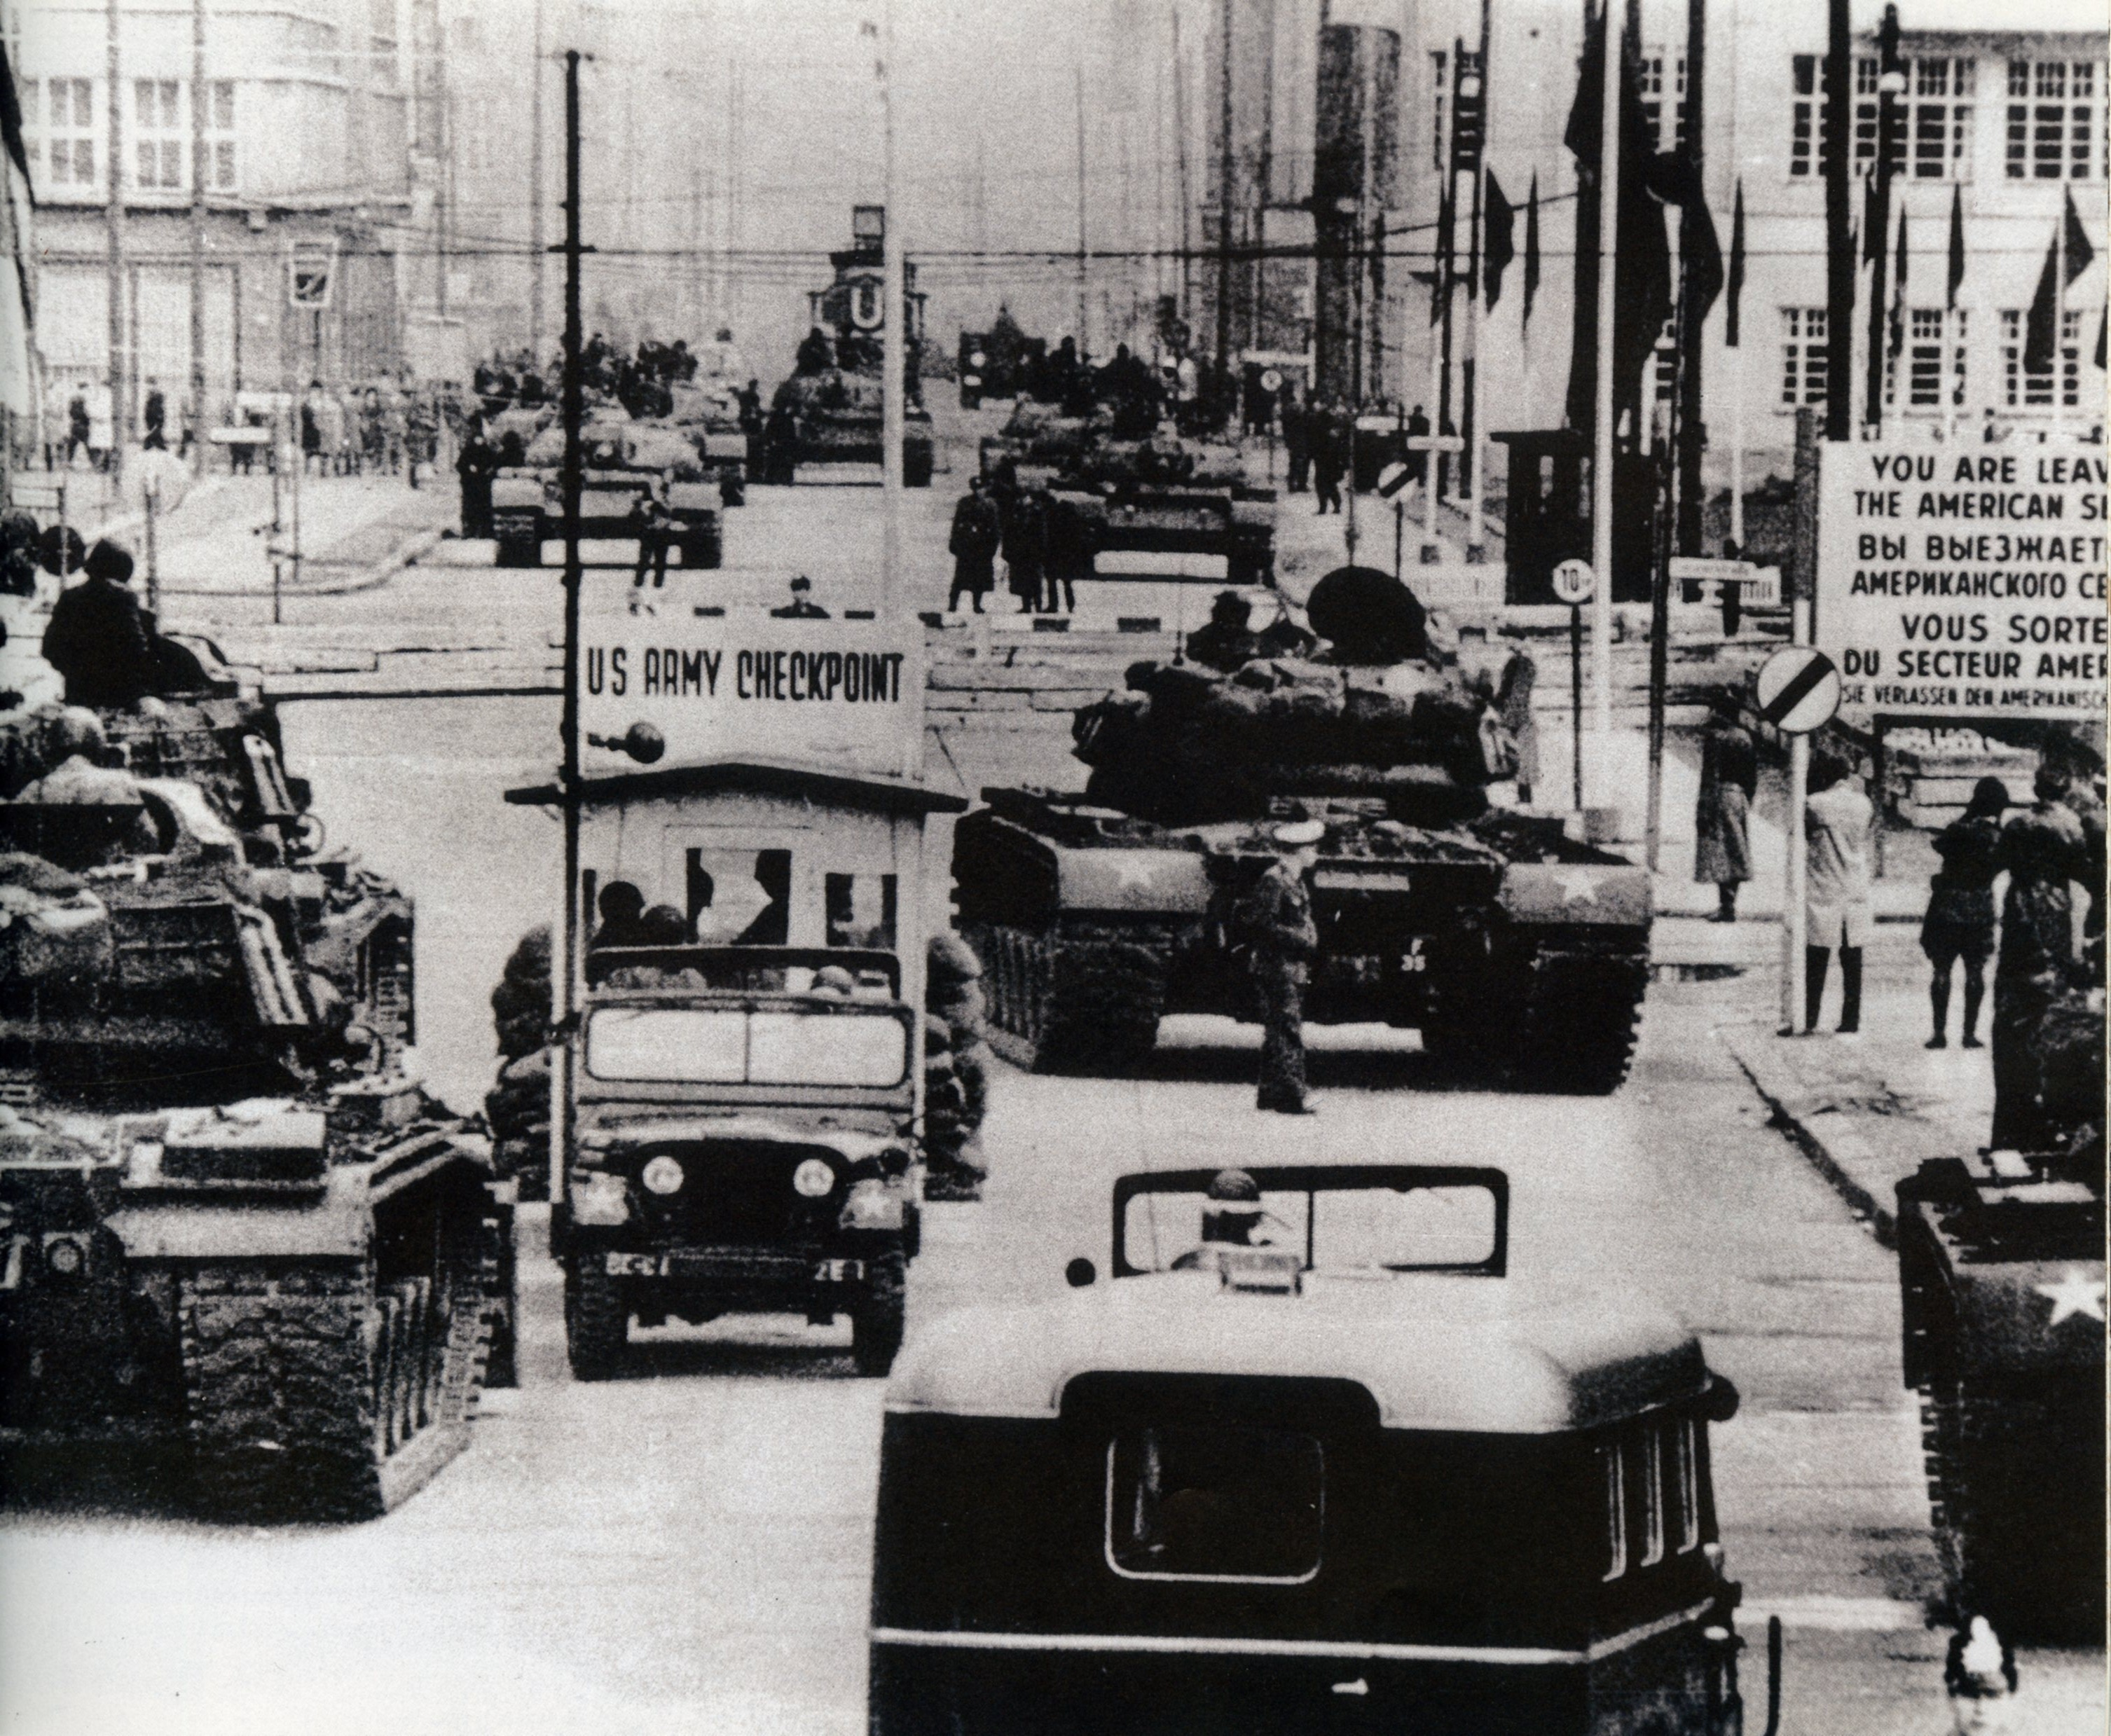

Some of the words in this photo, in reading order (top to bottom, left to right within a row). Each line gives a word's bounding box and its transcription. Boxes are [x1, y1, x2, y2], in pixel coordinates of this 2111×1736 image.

[1872, 455, 1934, 482] YOU
[1954, 457, 2015, 484] ARE
[1855, 490, 1900, 518] THE
[1918, 492, 2063, 521] AMERICAN
[1859, 534, 1906, 560] ВЫ
[1926, 535, 2103, 563] ВЫЕЗЖАЕТ
[1561, 568, 1579, 592] 10
[1850, 570, 2066, 599] АМЕРИКАНСКОГО
[1902, 614, 1988, 642] VOUS
[588, 647, 627, 696] US
[645, 647, 722, 696] ARMY
[737, 649, 905, 703] CHECKPOINT
[1843, 649, 1880, 677] DU
[1897, 649, 2021, 678] SECTEUR
[1874, 685, 1957, 705] VERLASSEN
[1965, 688, 1993, 705] DEN
